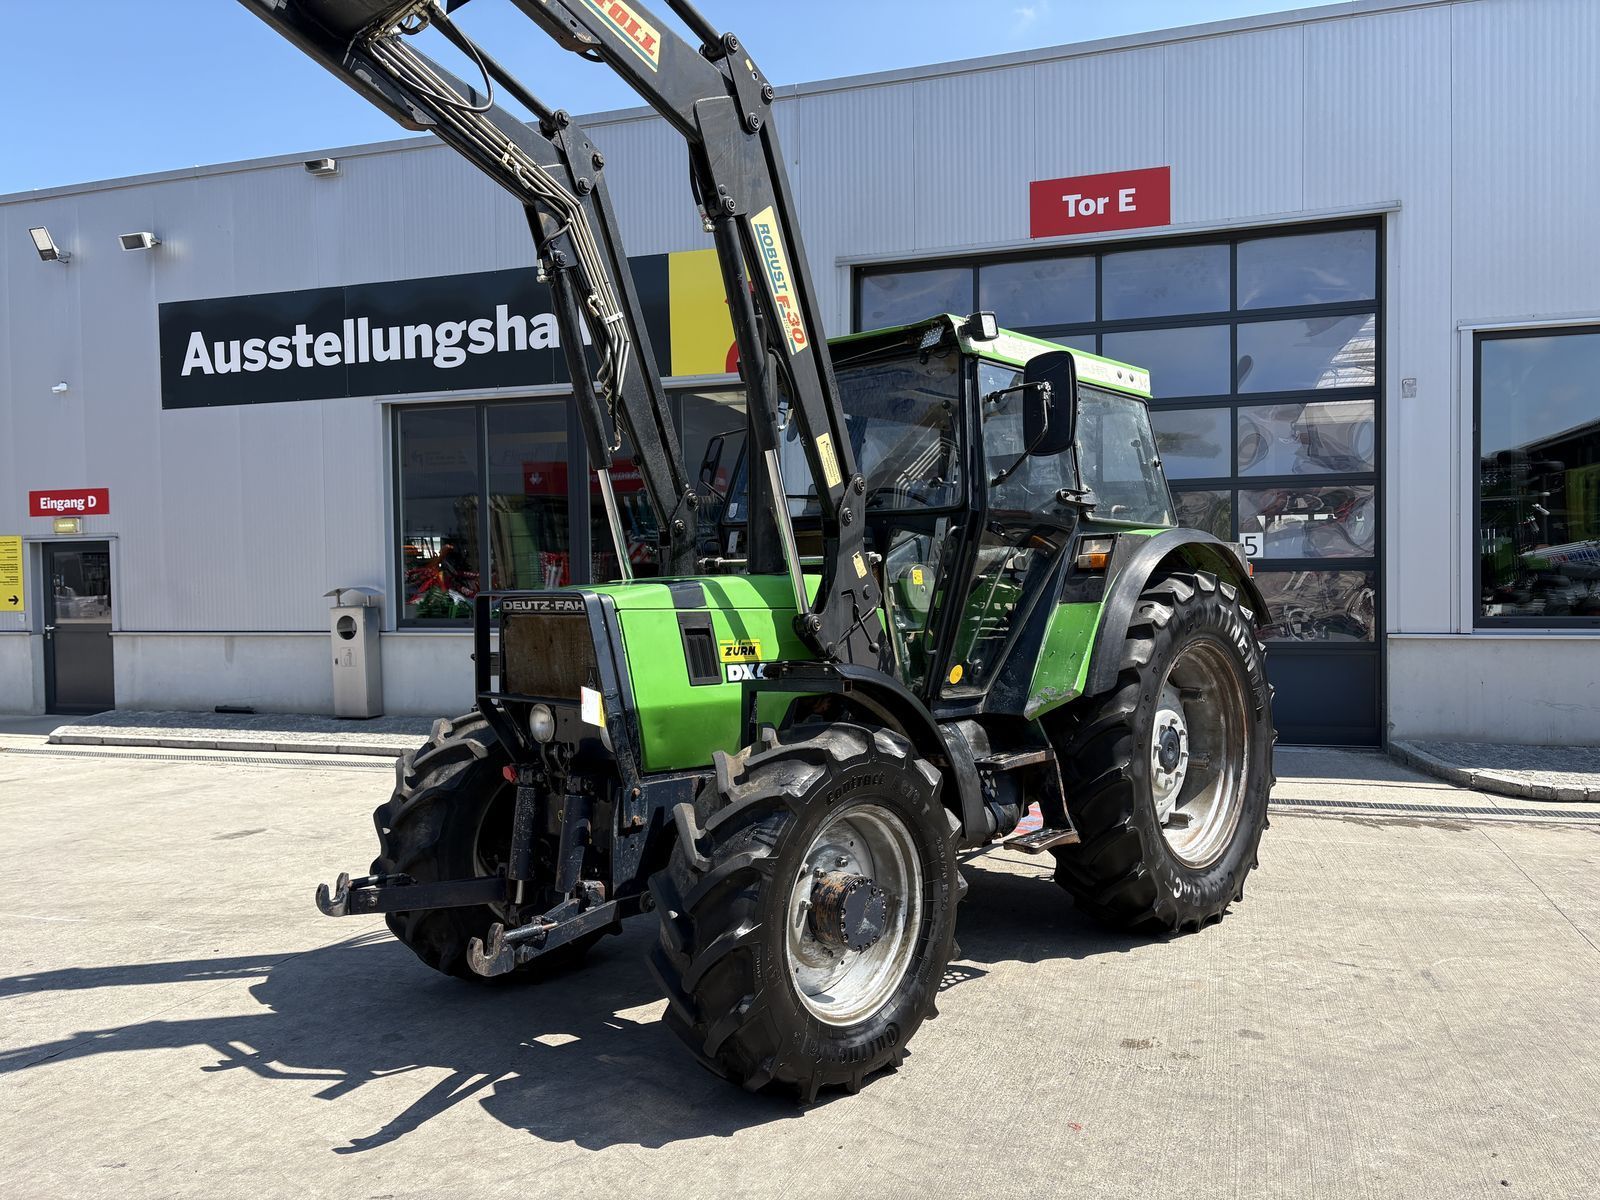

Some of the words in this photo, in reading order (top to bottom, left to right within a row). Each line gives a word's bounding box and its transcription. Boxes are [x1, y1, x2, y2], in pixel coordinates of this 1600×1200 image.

[593, 0, 657, 56] TOLL
[1062, 194, 1110, 218] Tor
[1118, 187, 1137, 213] E
[758, 223, 788, 292] ROBUST
[181, 304, 593, 377] Ausstellungsha
[40, 497, 86, 512] Eingang
[87, 495, 97, 508] D
[1245, 536, 1258, 556] 5
[502, 601, 585, 610] DEUTZ-FAH
